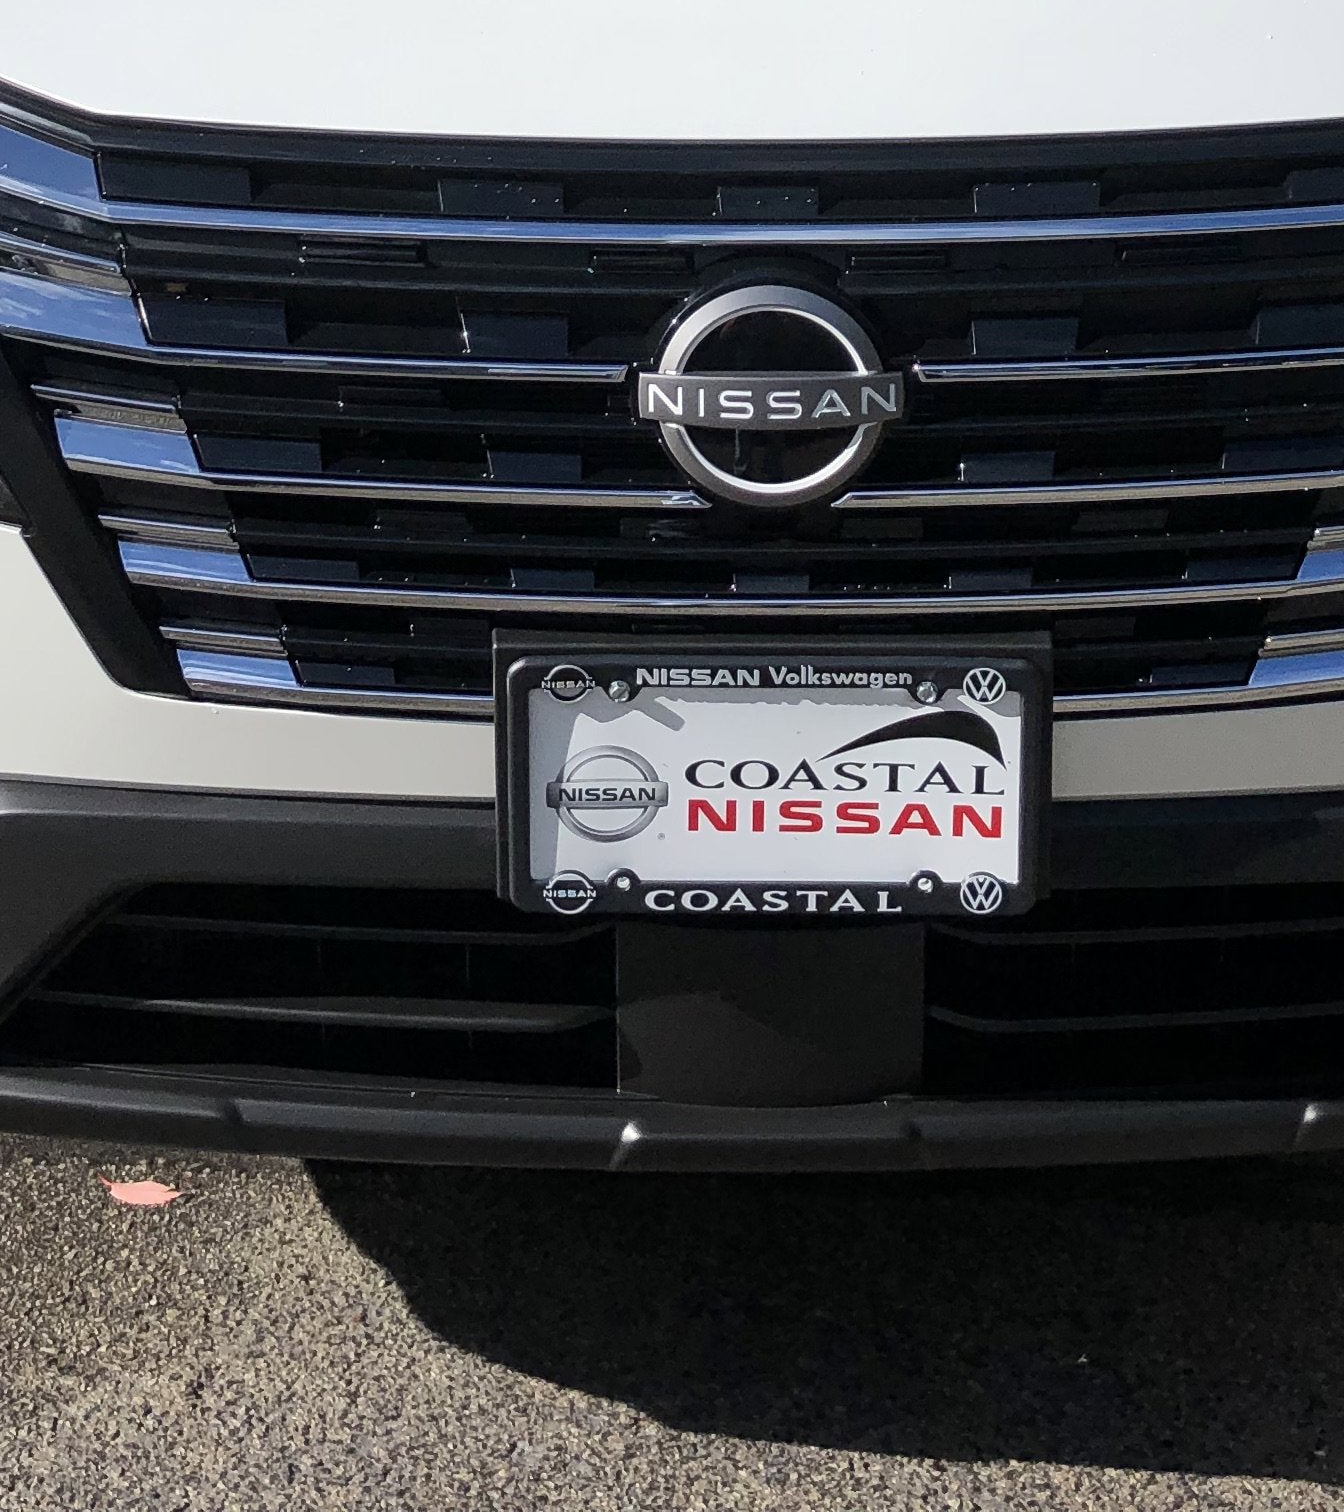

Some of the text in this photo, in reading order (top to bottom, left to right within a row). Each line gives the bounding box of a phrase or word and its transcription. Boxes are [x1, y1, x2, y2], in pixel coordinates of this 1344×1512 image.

[647, 383, 898, 420] NISSAN
[541, 680, 596, 689] NISSAN
[636, 664, 913, 689] NISSAN Volkswagen
[684, 758, 1006, 796] COASTAL
[558, 787, 656, 802] NISSAN
[687, 798, 1003, 839] NISSAN
[542, 889, 597, 898] NISSAN
[644, 887, 903, 913] COASTAL
